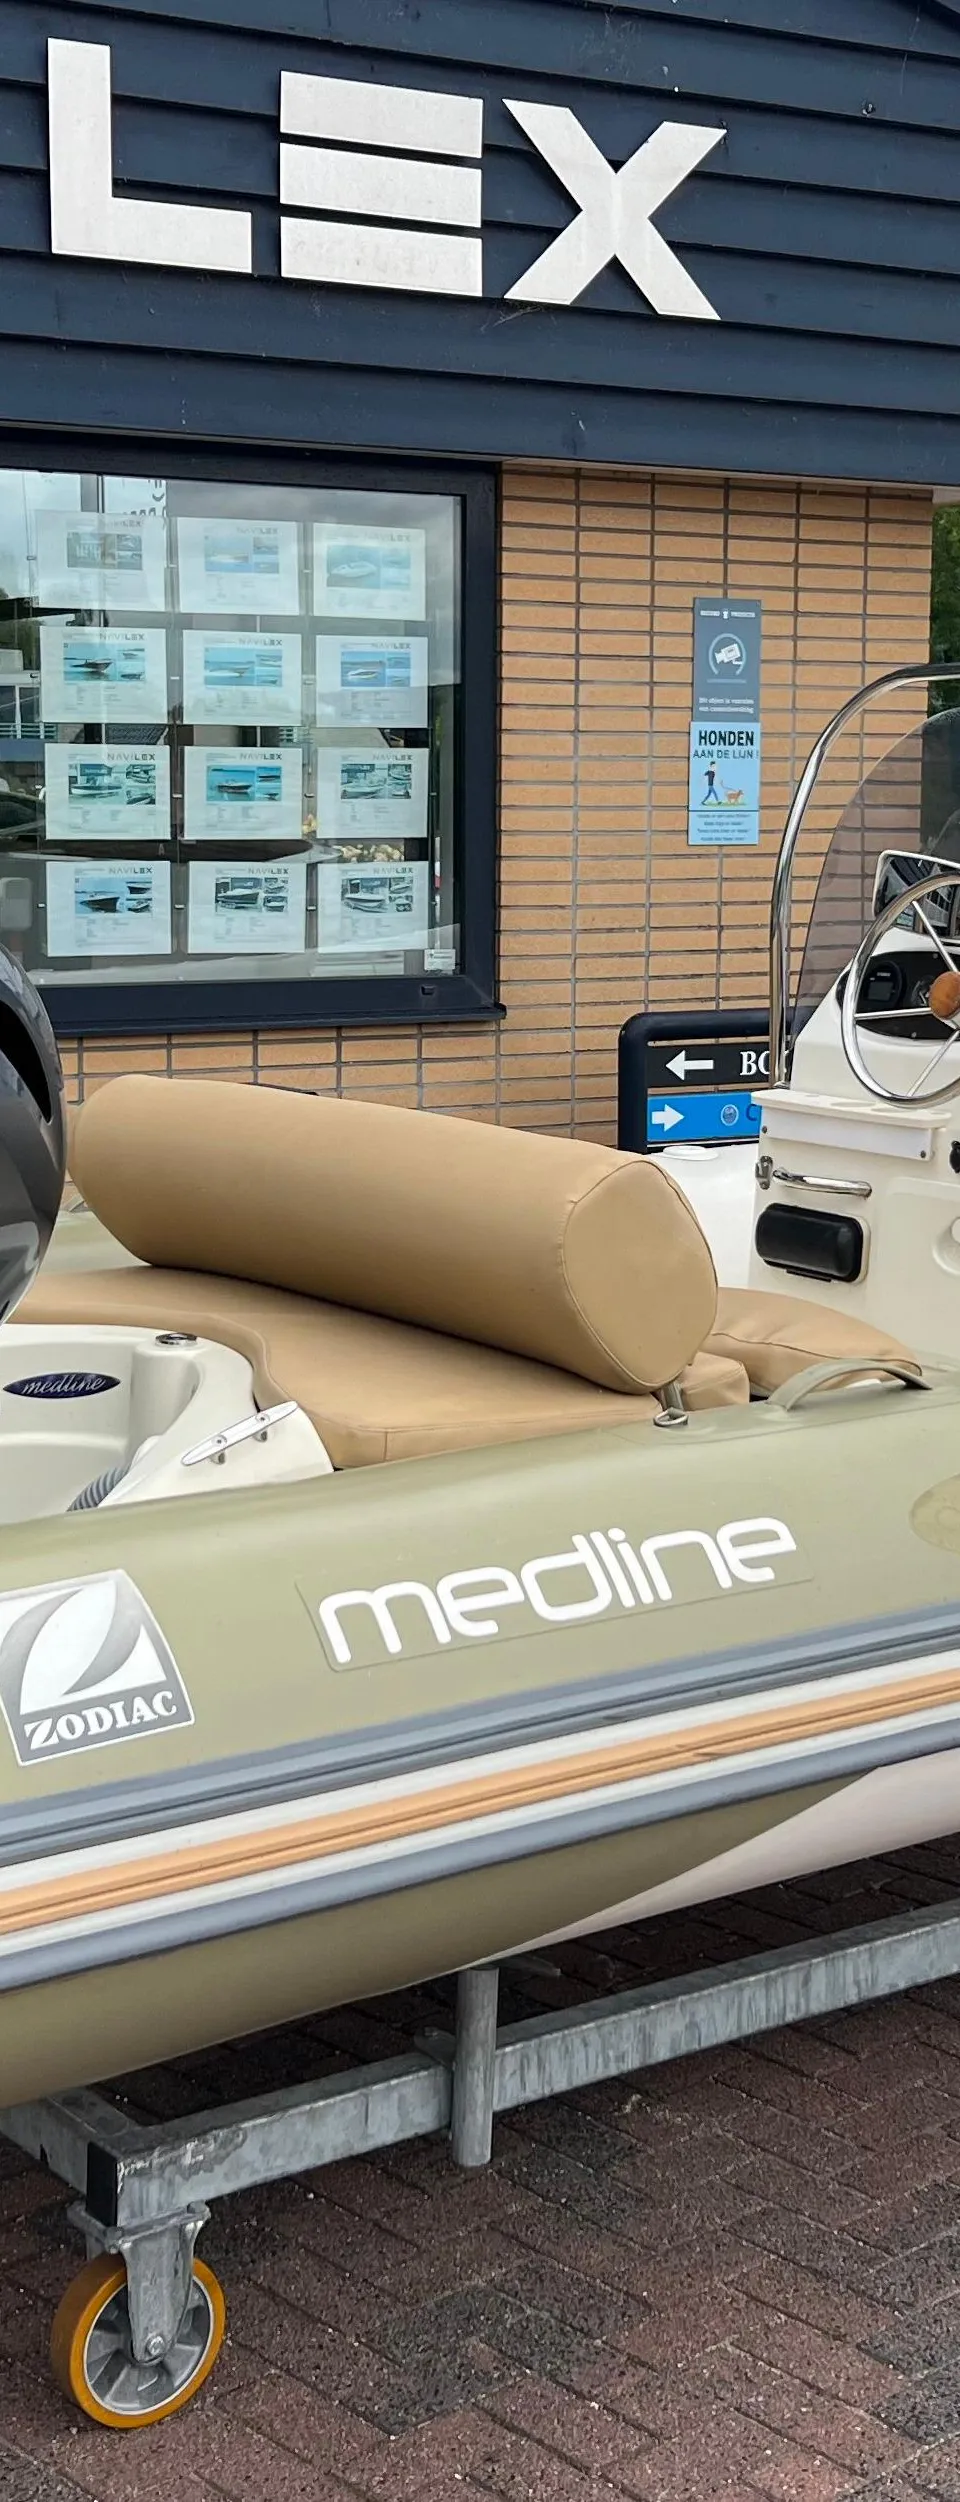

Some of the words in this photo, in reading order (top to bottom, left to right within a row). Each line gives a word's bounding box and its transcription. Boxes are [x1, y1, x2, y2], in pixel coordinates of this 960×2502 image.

[47, 37, 728, 321] LEX
[698, 729, 755, 746] HONDEN
[107, 753, 156, 761] NAVILEX
[239, 753, 283, 761] NAVILEX
[693, 749, 714, 759] AAN
[716, 749, 730, 760] DE
[732, 750, 754, 760] LIJN
[108, 867, 153, 875] NAVILEX
[248, 867, 290, 875] NAVILEX
[373, 867, 414, 875] NAVILEX
[20, 1373, 106, 1395] medline
[318, 1517, 797, 1664] medline
[23, 1690, 178, 1751] ZODIAC
